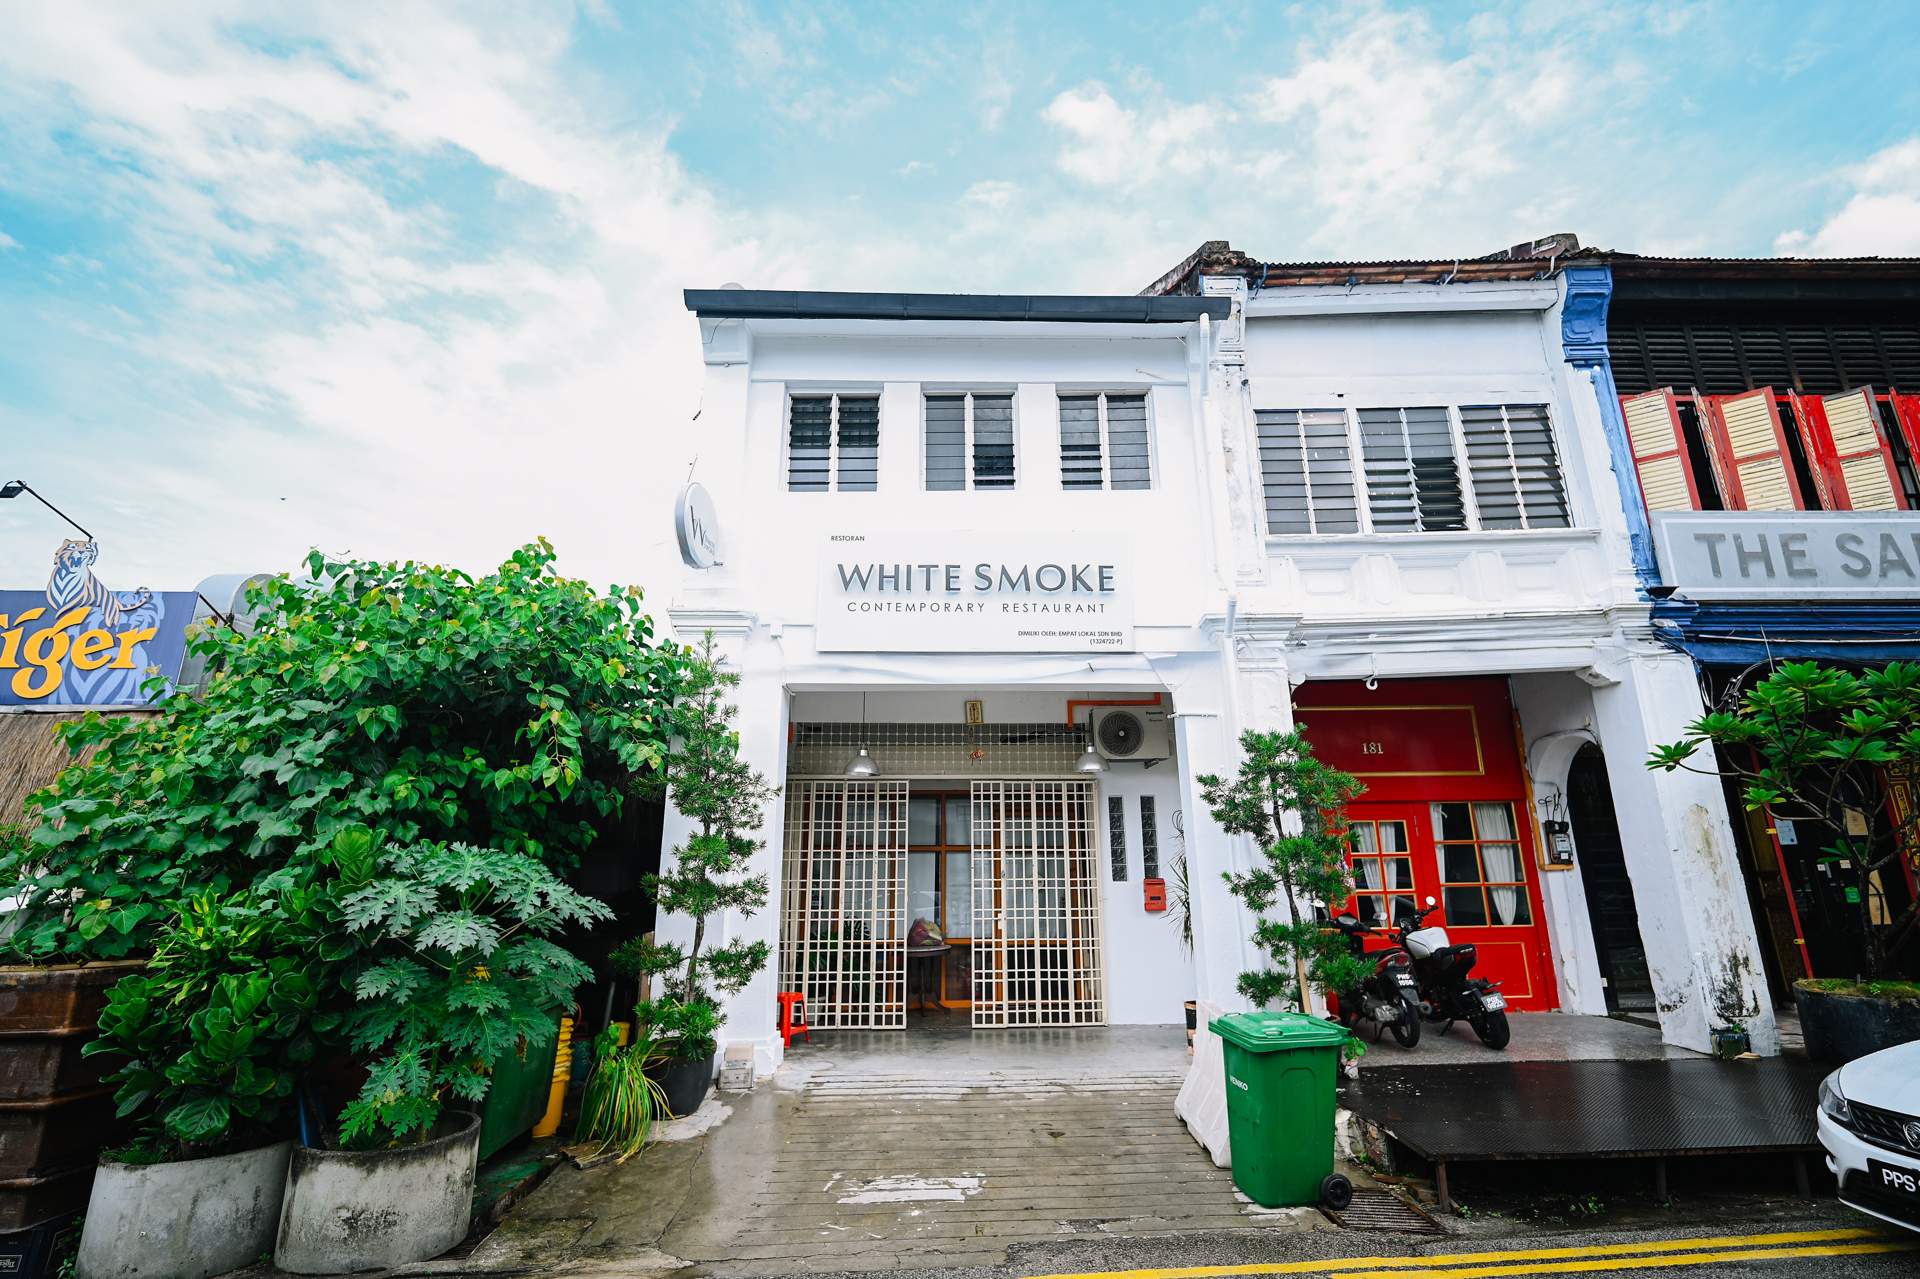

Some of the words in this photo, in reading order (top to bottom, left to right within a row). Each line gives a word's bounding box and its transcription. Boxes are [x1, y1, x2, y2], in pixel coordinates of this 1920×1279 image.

[1693, 533, 1818, 578] THE
[1834, 533, 1920, 578] SA
[837, 563, 962, 592] WHITE
[974, 563, 1115, 592] SMOKE
[847, 602, 985, 613] CONTEMPORARY
[1002, 602, 1106, 613] RESTAURANT
[0, 606, 159, 699] iger
[1361, 742, 1384, 754] 181
[1881, 1168, 1917, 1193] PPS
